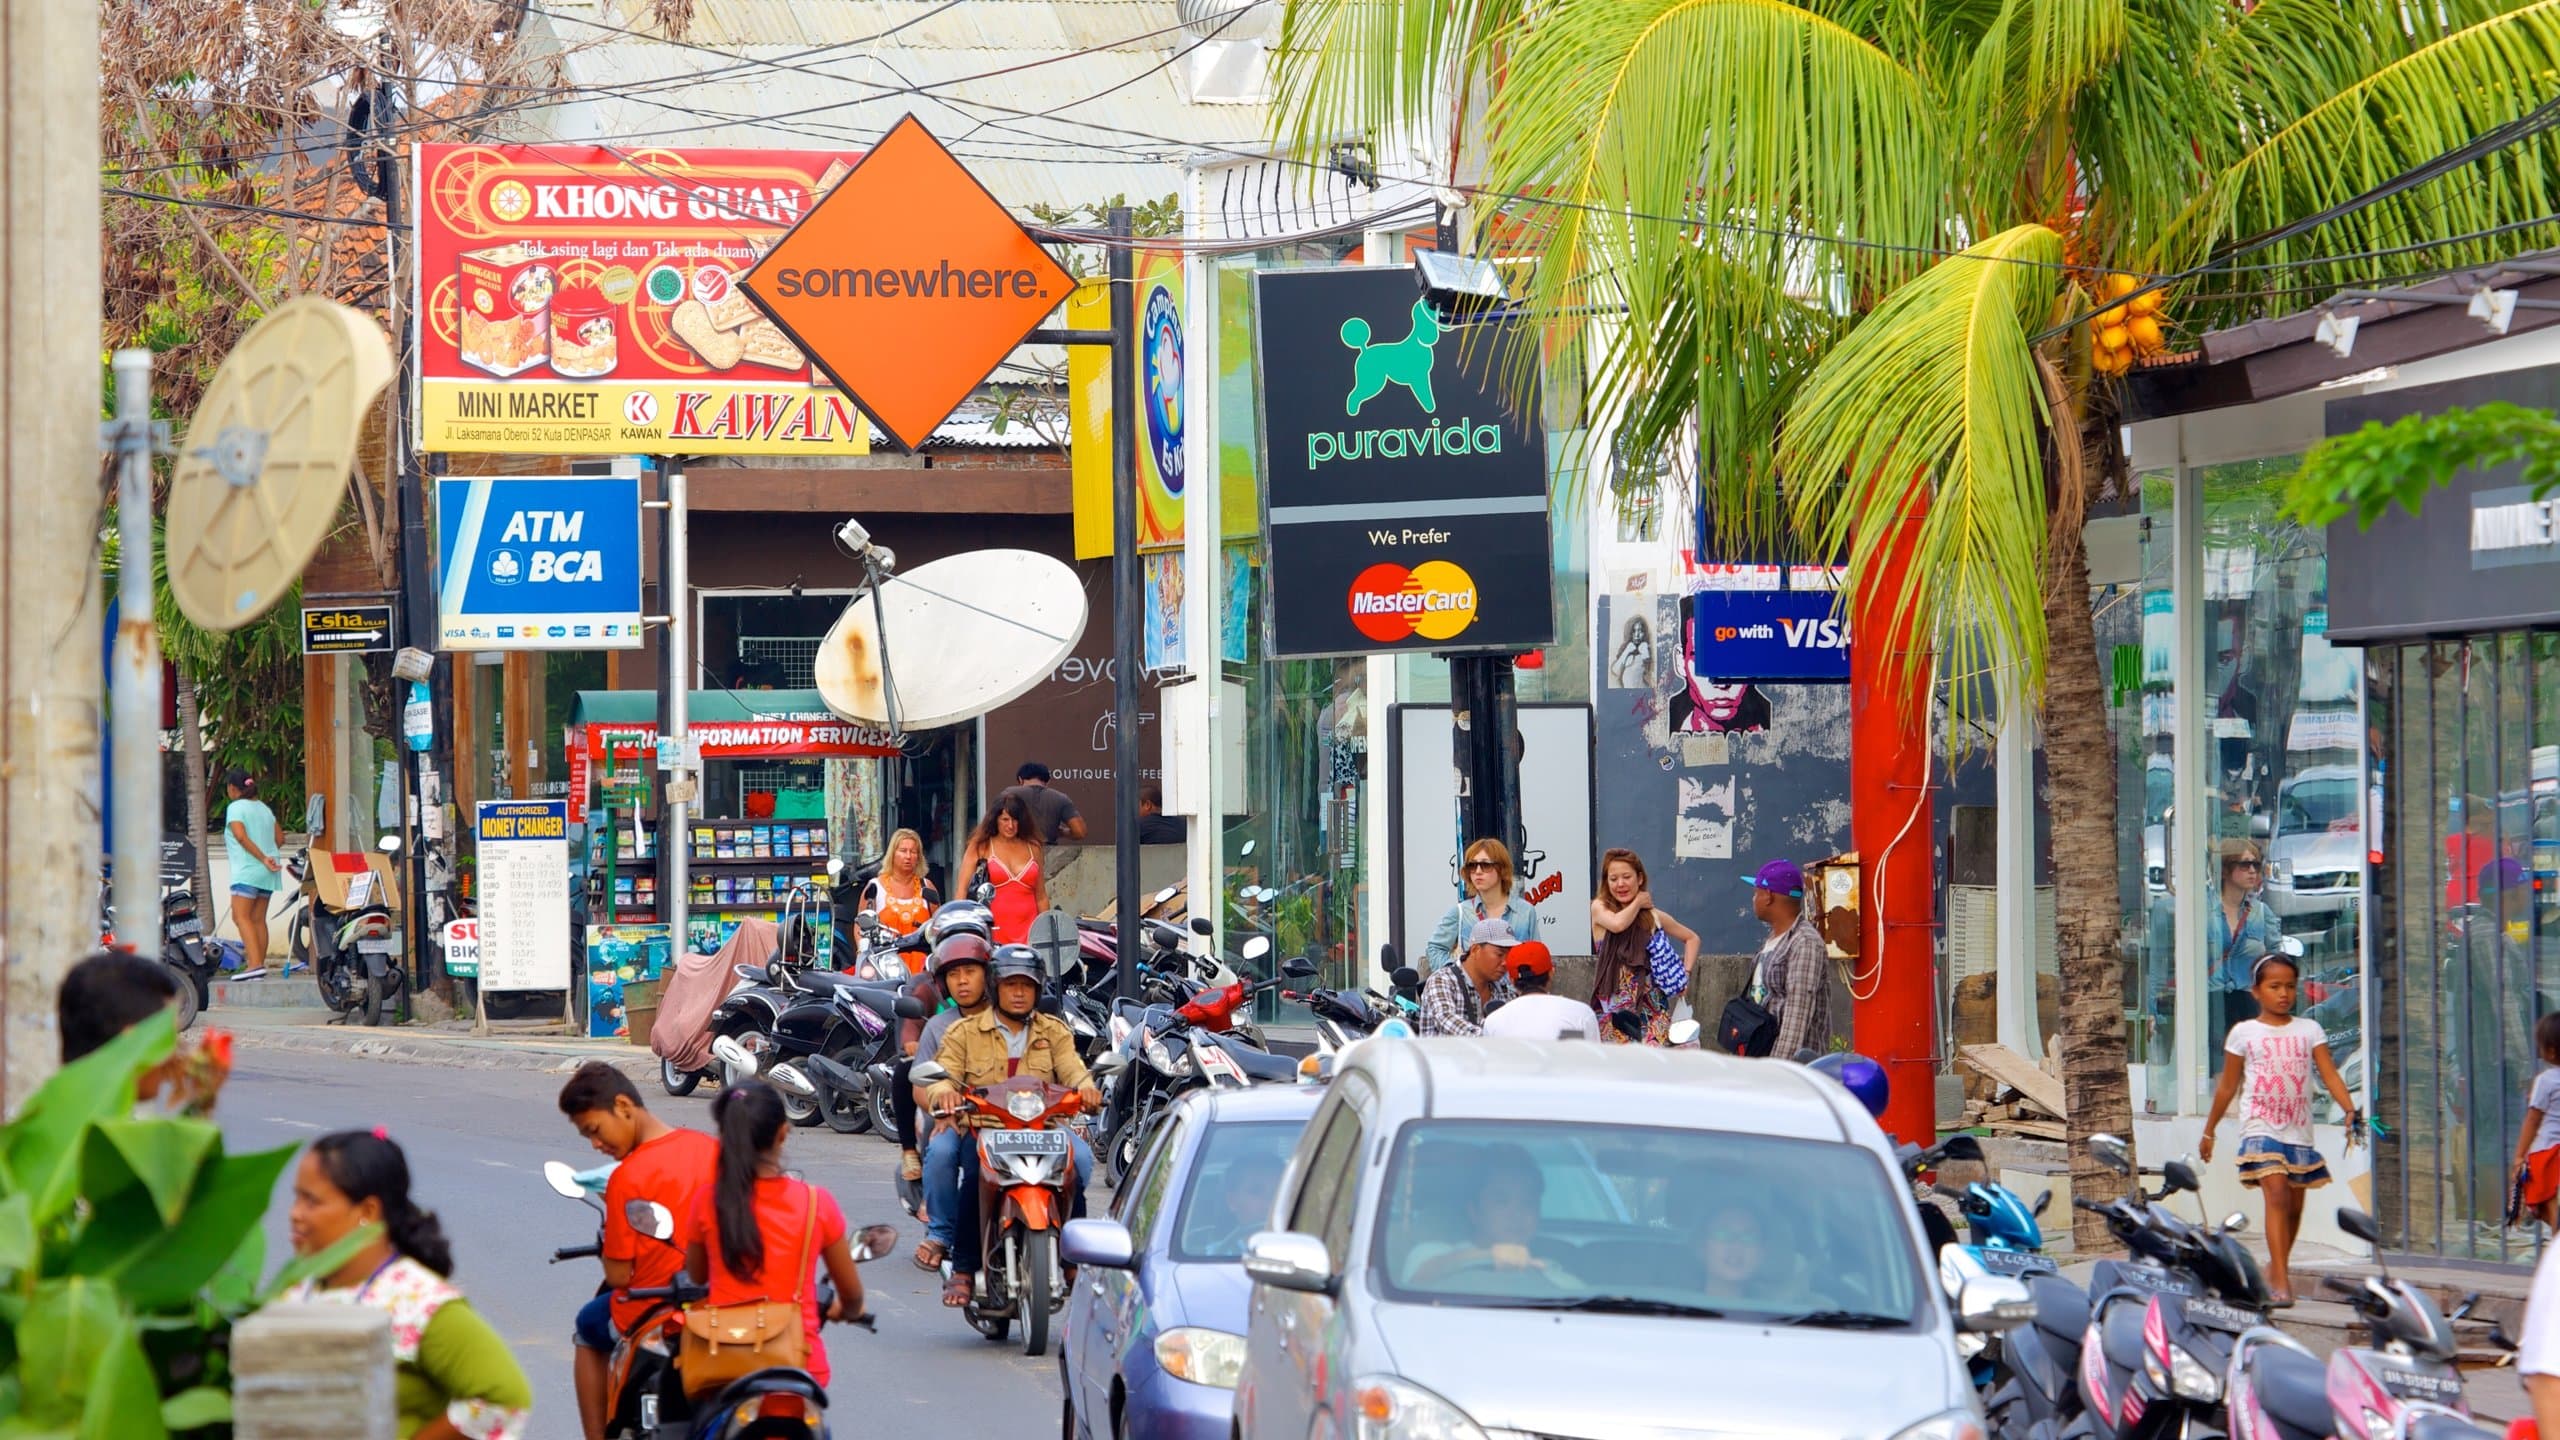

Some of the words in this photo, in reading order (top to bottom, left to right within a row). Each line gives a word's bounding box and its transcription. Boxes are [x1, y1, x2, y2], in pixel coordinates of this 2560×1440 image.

[534, 184, 680, 220] KHONG
[687, 186, 801, 222] GUAN
[520, 241, 546, 257] Tak
[550, 243, 590, 259] asing
[592, 241, 618, 260] lagi
[622, 242, 649, 257] dan
[653, 242, 680, 257] Tak
[684, 243, 710, 258] ada
[777, 260, 1047, 298] somewhere.
[458, 391, 501, 418] MINI
[508, 392, 599, 419] MARKET
[668, 391, 858, 443] KAWAN
[456, 427, 502, 441] Laksamana
[504, 428, 530, 441] Oberoi
[532, 428, 542, 441] 52
[544, 428, 562, 441] Kuta
[564, 428, 612, 442] DENPASAR
[620, 428, 662, 440] KAWAN
[1308, 417, 1501, 471] puravida
[1162, 437, 1173, 475] Es
[501, 510, 584, 543] ATM
[1368, 530, 1397, 546] We
[1402, 528, 1451, 545] Prefer
[528, 550, 603, 583] BCA
[1353, 587, 1473, 615] MasterCard
[307, 612, 364, 629] Esha
[444, 628, 466, 638] VISA
[1714, 626, 1737, 642] go
[1739, 623, 1774, 639] with
[790, 711, 837, 722] CHANGER
[687, 726, 804, 748] NFORMATION
[1050, 768, 1110, 780] OUTIQUE
[495, 805, 550, 816] AUTHORIZED
[482, 816, 516, 838] MONEY
[517, 816, 564, 838] CHANGER
[2262, 1035, 2309, 1060] STILL
[2253, 1074, 2307, 1098] MY
